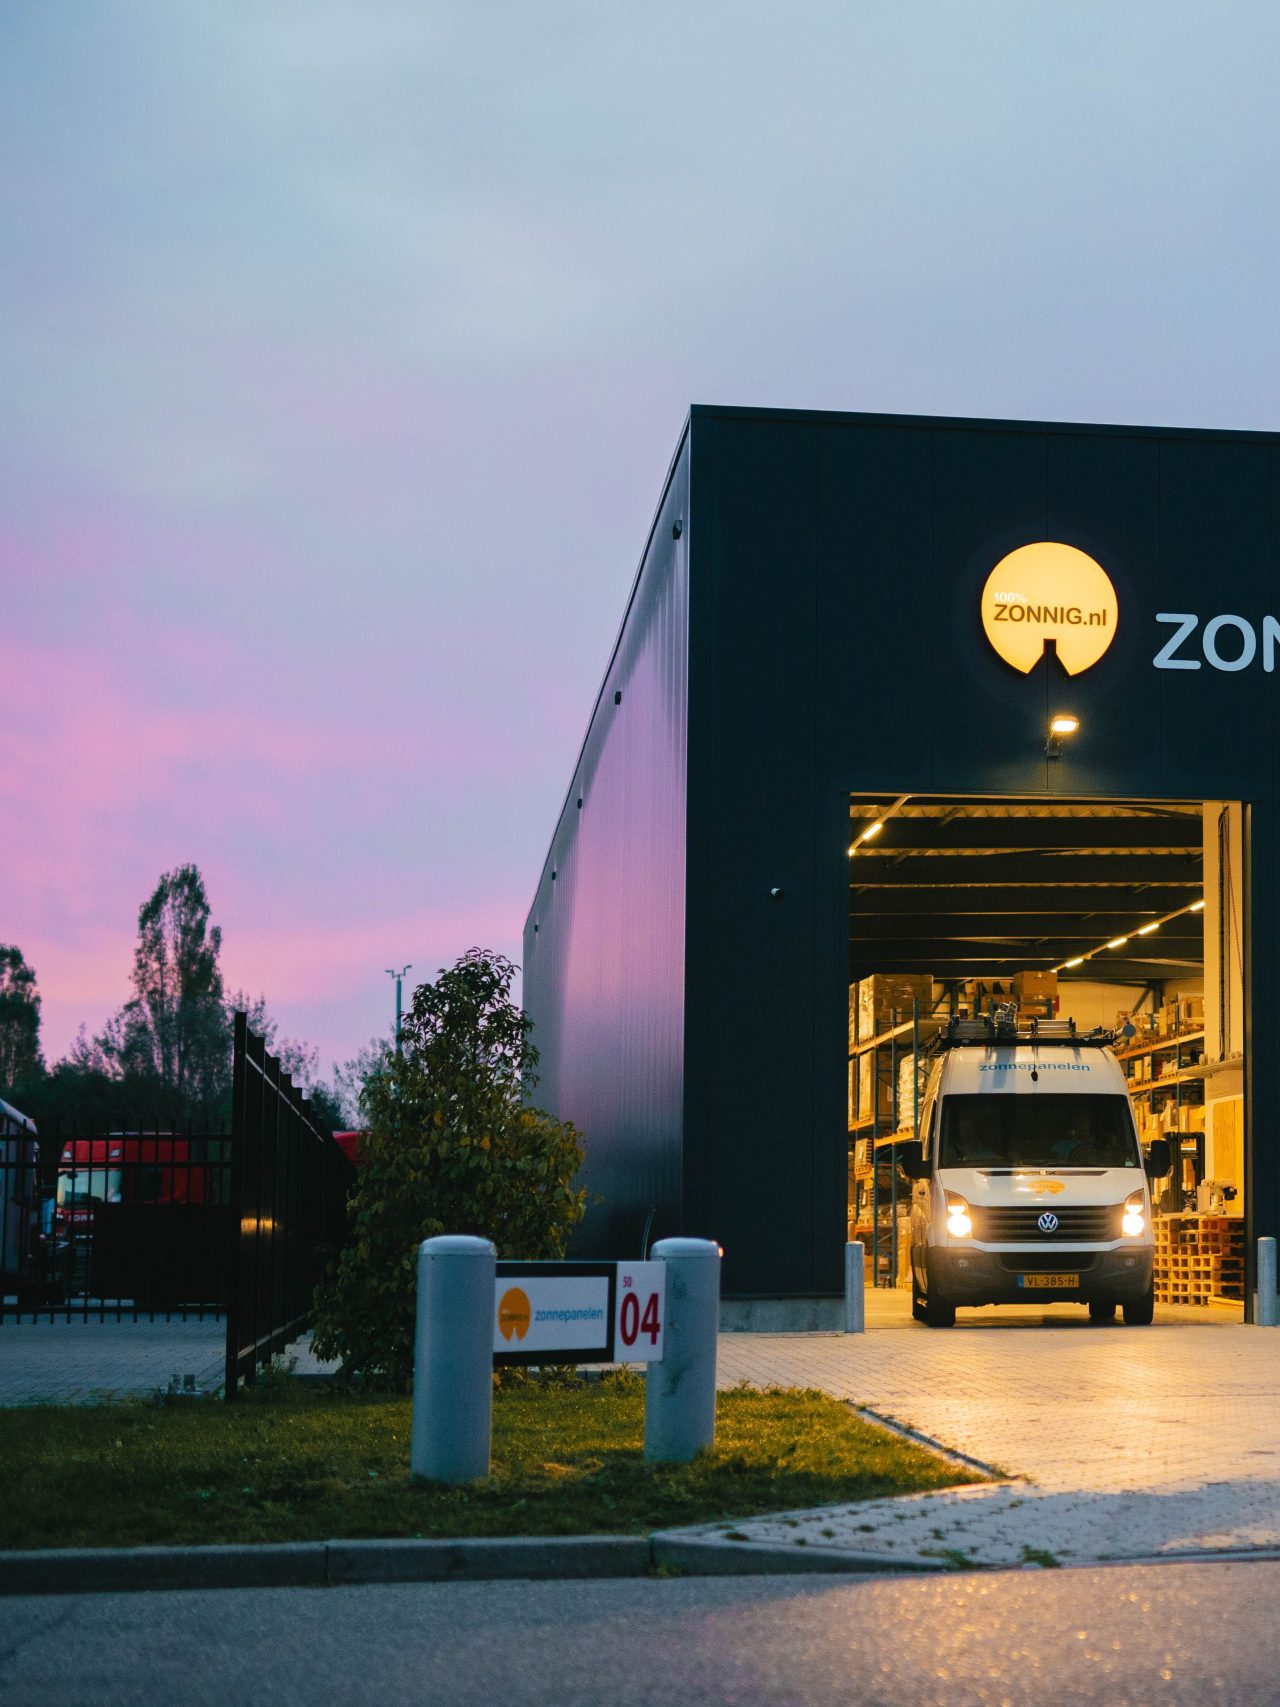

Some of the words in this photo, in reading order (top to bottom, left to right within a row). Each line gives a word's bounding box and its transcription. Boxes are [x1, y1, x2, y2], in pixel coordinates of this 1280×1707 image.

[994, 604, 1106, 626] ZONNIG.nl
[979, 1062, 1091, 1072] zonnepanelen
[1027, 1276, 1075, 1287] VL-385-H
[535, 1307, 604, 1324] zonnepanelen
[620, 1292, 660, 1347] 04
